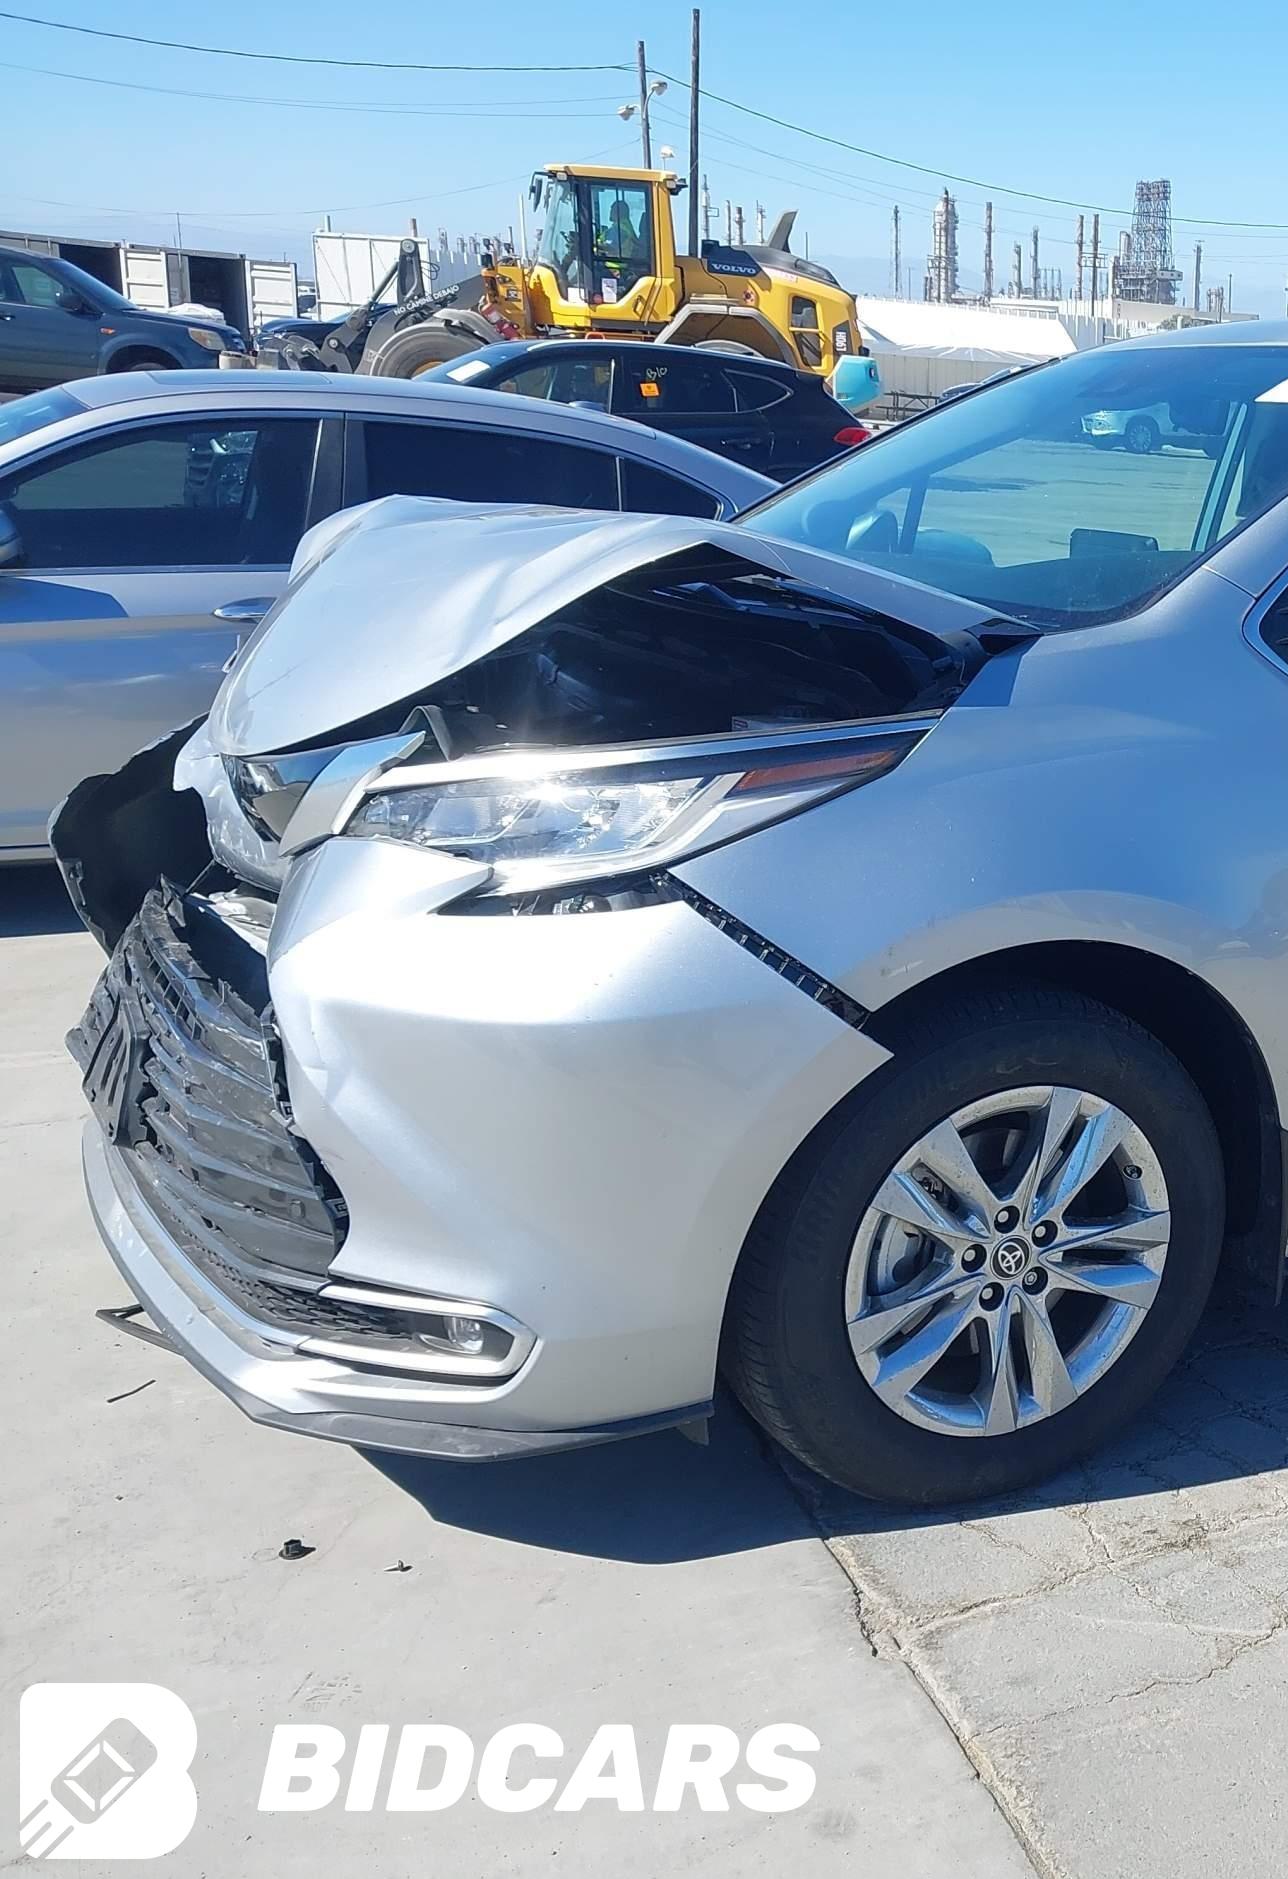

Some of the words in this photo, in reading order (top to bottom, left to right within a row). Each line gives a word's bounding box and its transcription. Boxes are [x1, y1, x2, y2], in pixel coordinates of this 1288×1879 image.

[712, 263, 756, 274] VOLVO
[393, 306, 406, 316] NO
[406, 295, 434, 311] CAMINE
[432, 285, 460, 300] DEBAJO
[835, 331, 847, 351] L90H
